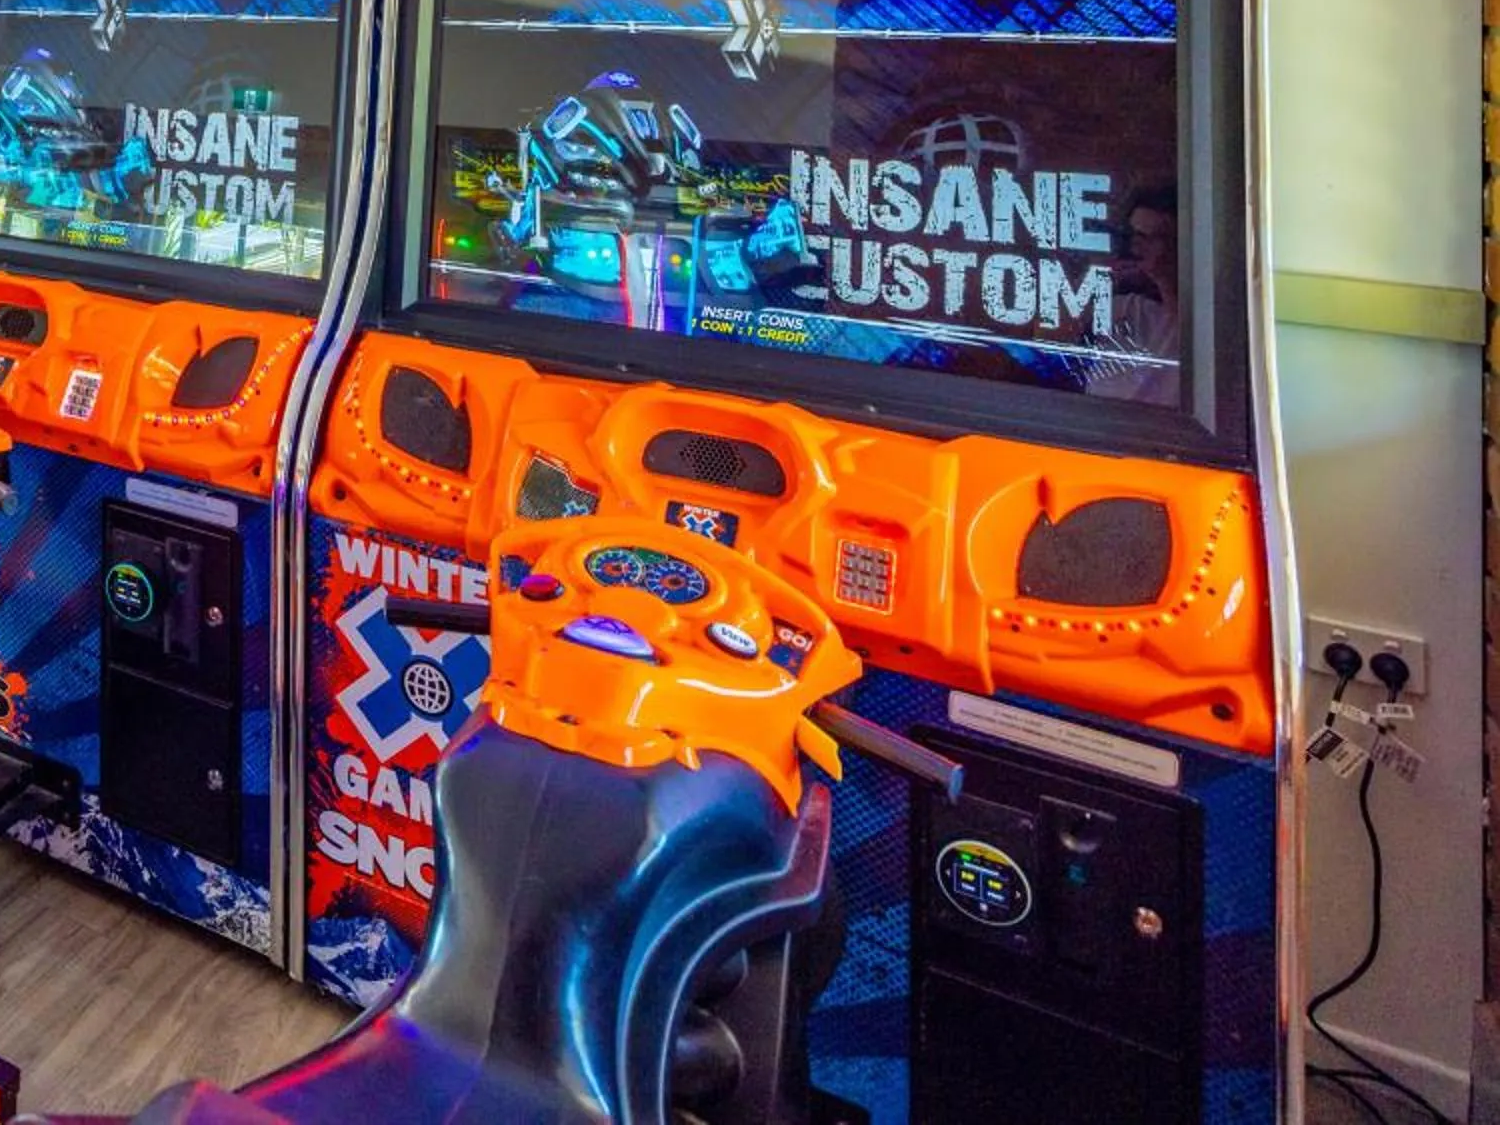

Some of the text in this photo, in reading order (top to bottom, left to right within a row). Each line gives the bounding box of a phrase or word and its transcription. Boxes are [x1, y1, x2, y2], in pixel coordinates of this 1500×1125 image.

[124, 103, 301, 172] INSANE
[142, 169, 296, 225] USTOM
[790, 149, 1112, 253] INSANE
[701, 305, 805, 330] INSERT COINS
[701, 320, 735, 334] COIN
[757, 327, 809, 343] CREDIT
[335, 532, 491, 606] WINTE
